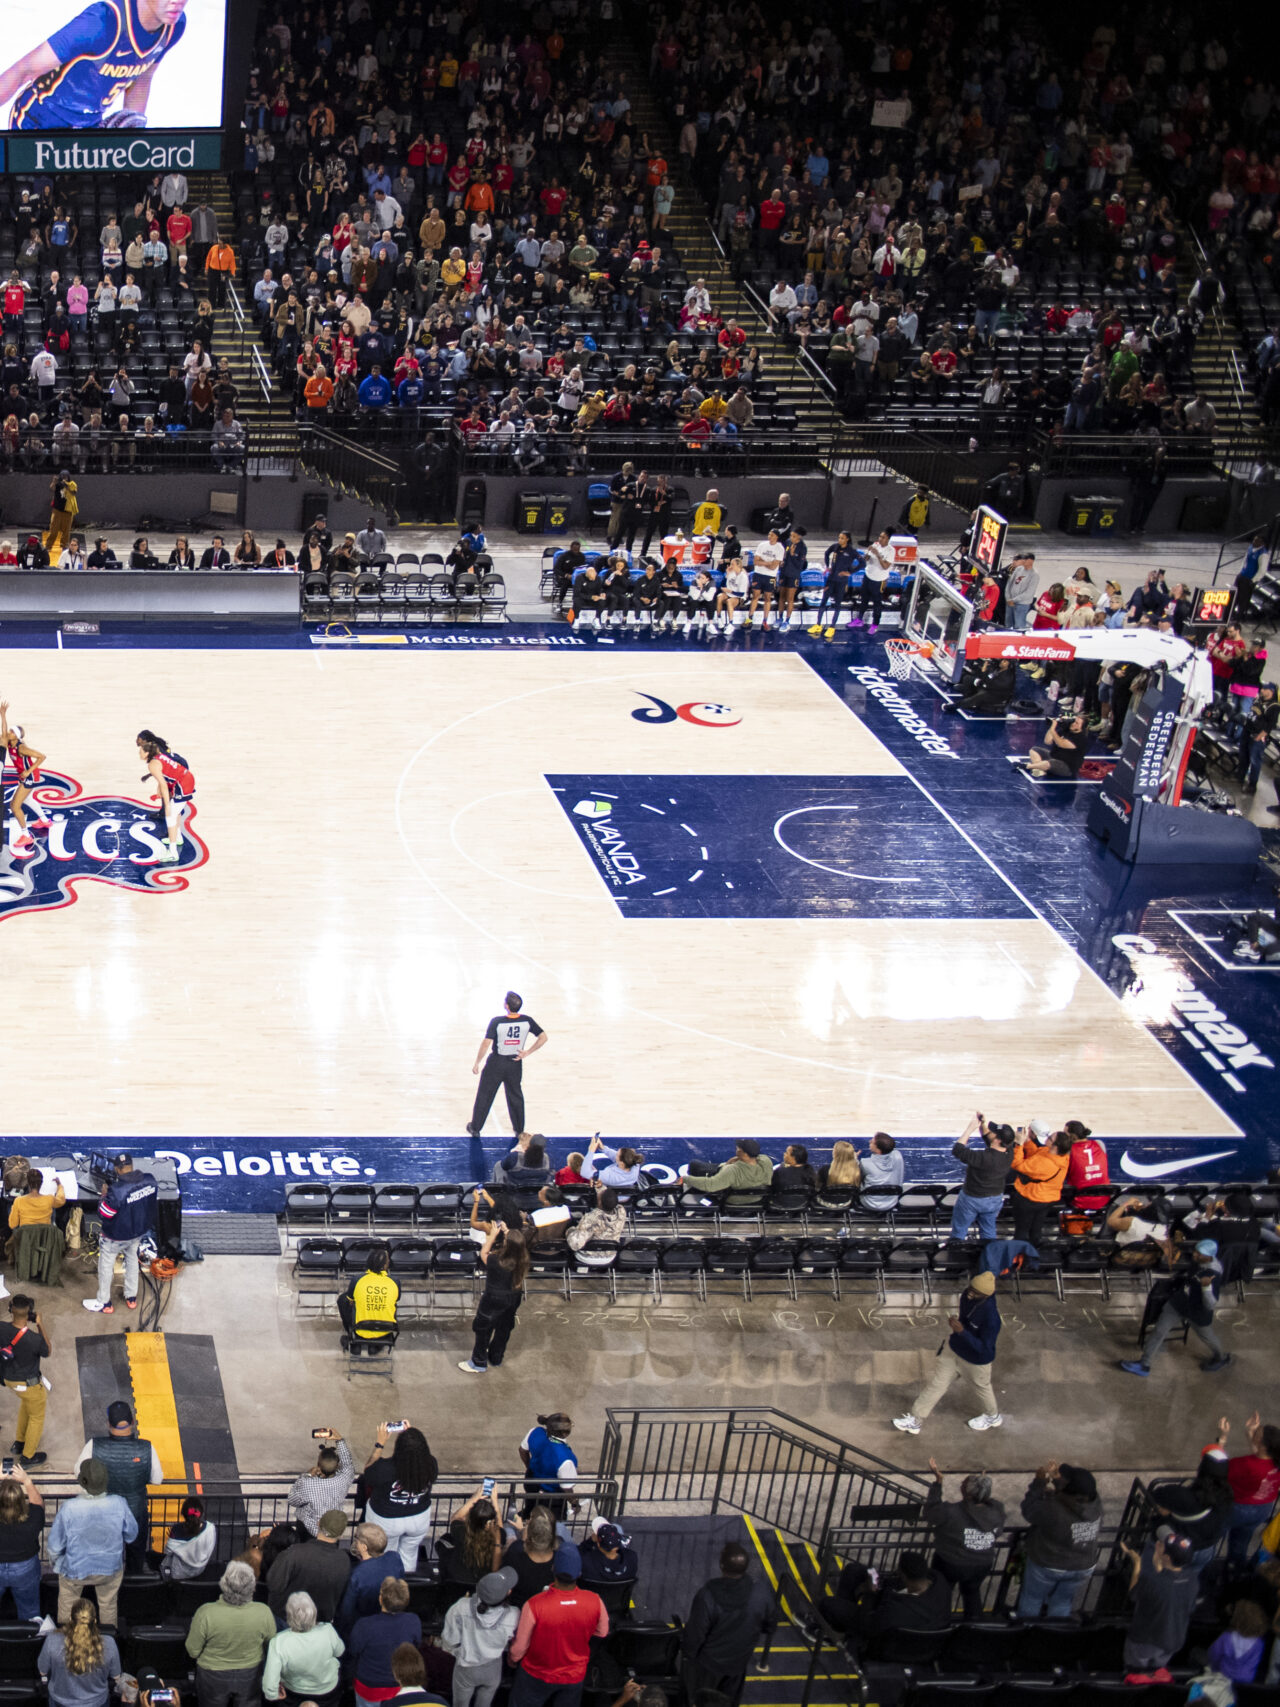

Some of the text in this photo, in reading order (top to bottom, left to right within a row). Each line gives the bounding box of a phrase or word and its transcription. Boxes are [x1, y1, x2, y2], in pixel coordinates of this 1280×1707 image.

[897, 548, 908, 557] G
[977, 532, 997, 566] 24
[1203, 591, 1230, 606] 10:00
[1200, 604, 1222, 620] 24
[409, 635, 587, 646] MedStar Health
[847, 666, 960, 759] ticketmaster
[1138, 717, 1162, 787] BEDERMAN
[1149, 711, 1175, 787] GREENBERG
[591, 818, 646, 884] VANDA
[506, 1026, 521, 1039] 42
[366, 1286, 388, 1295] CSC
[366, 1296, 387, 1304] EVENT
